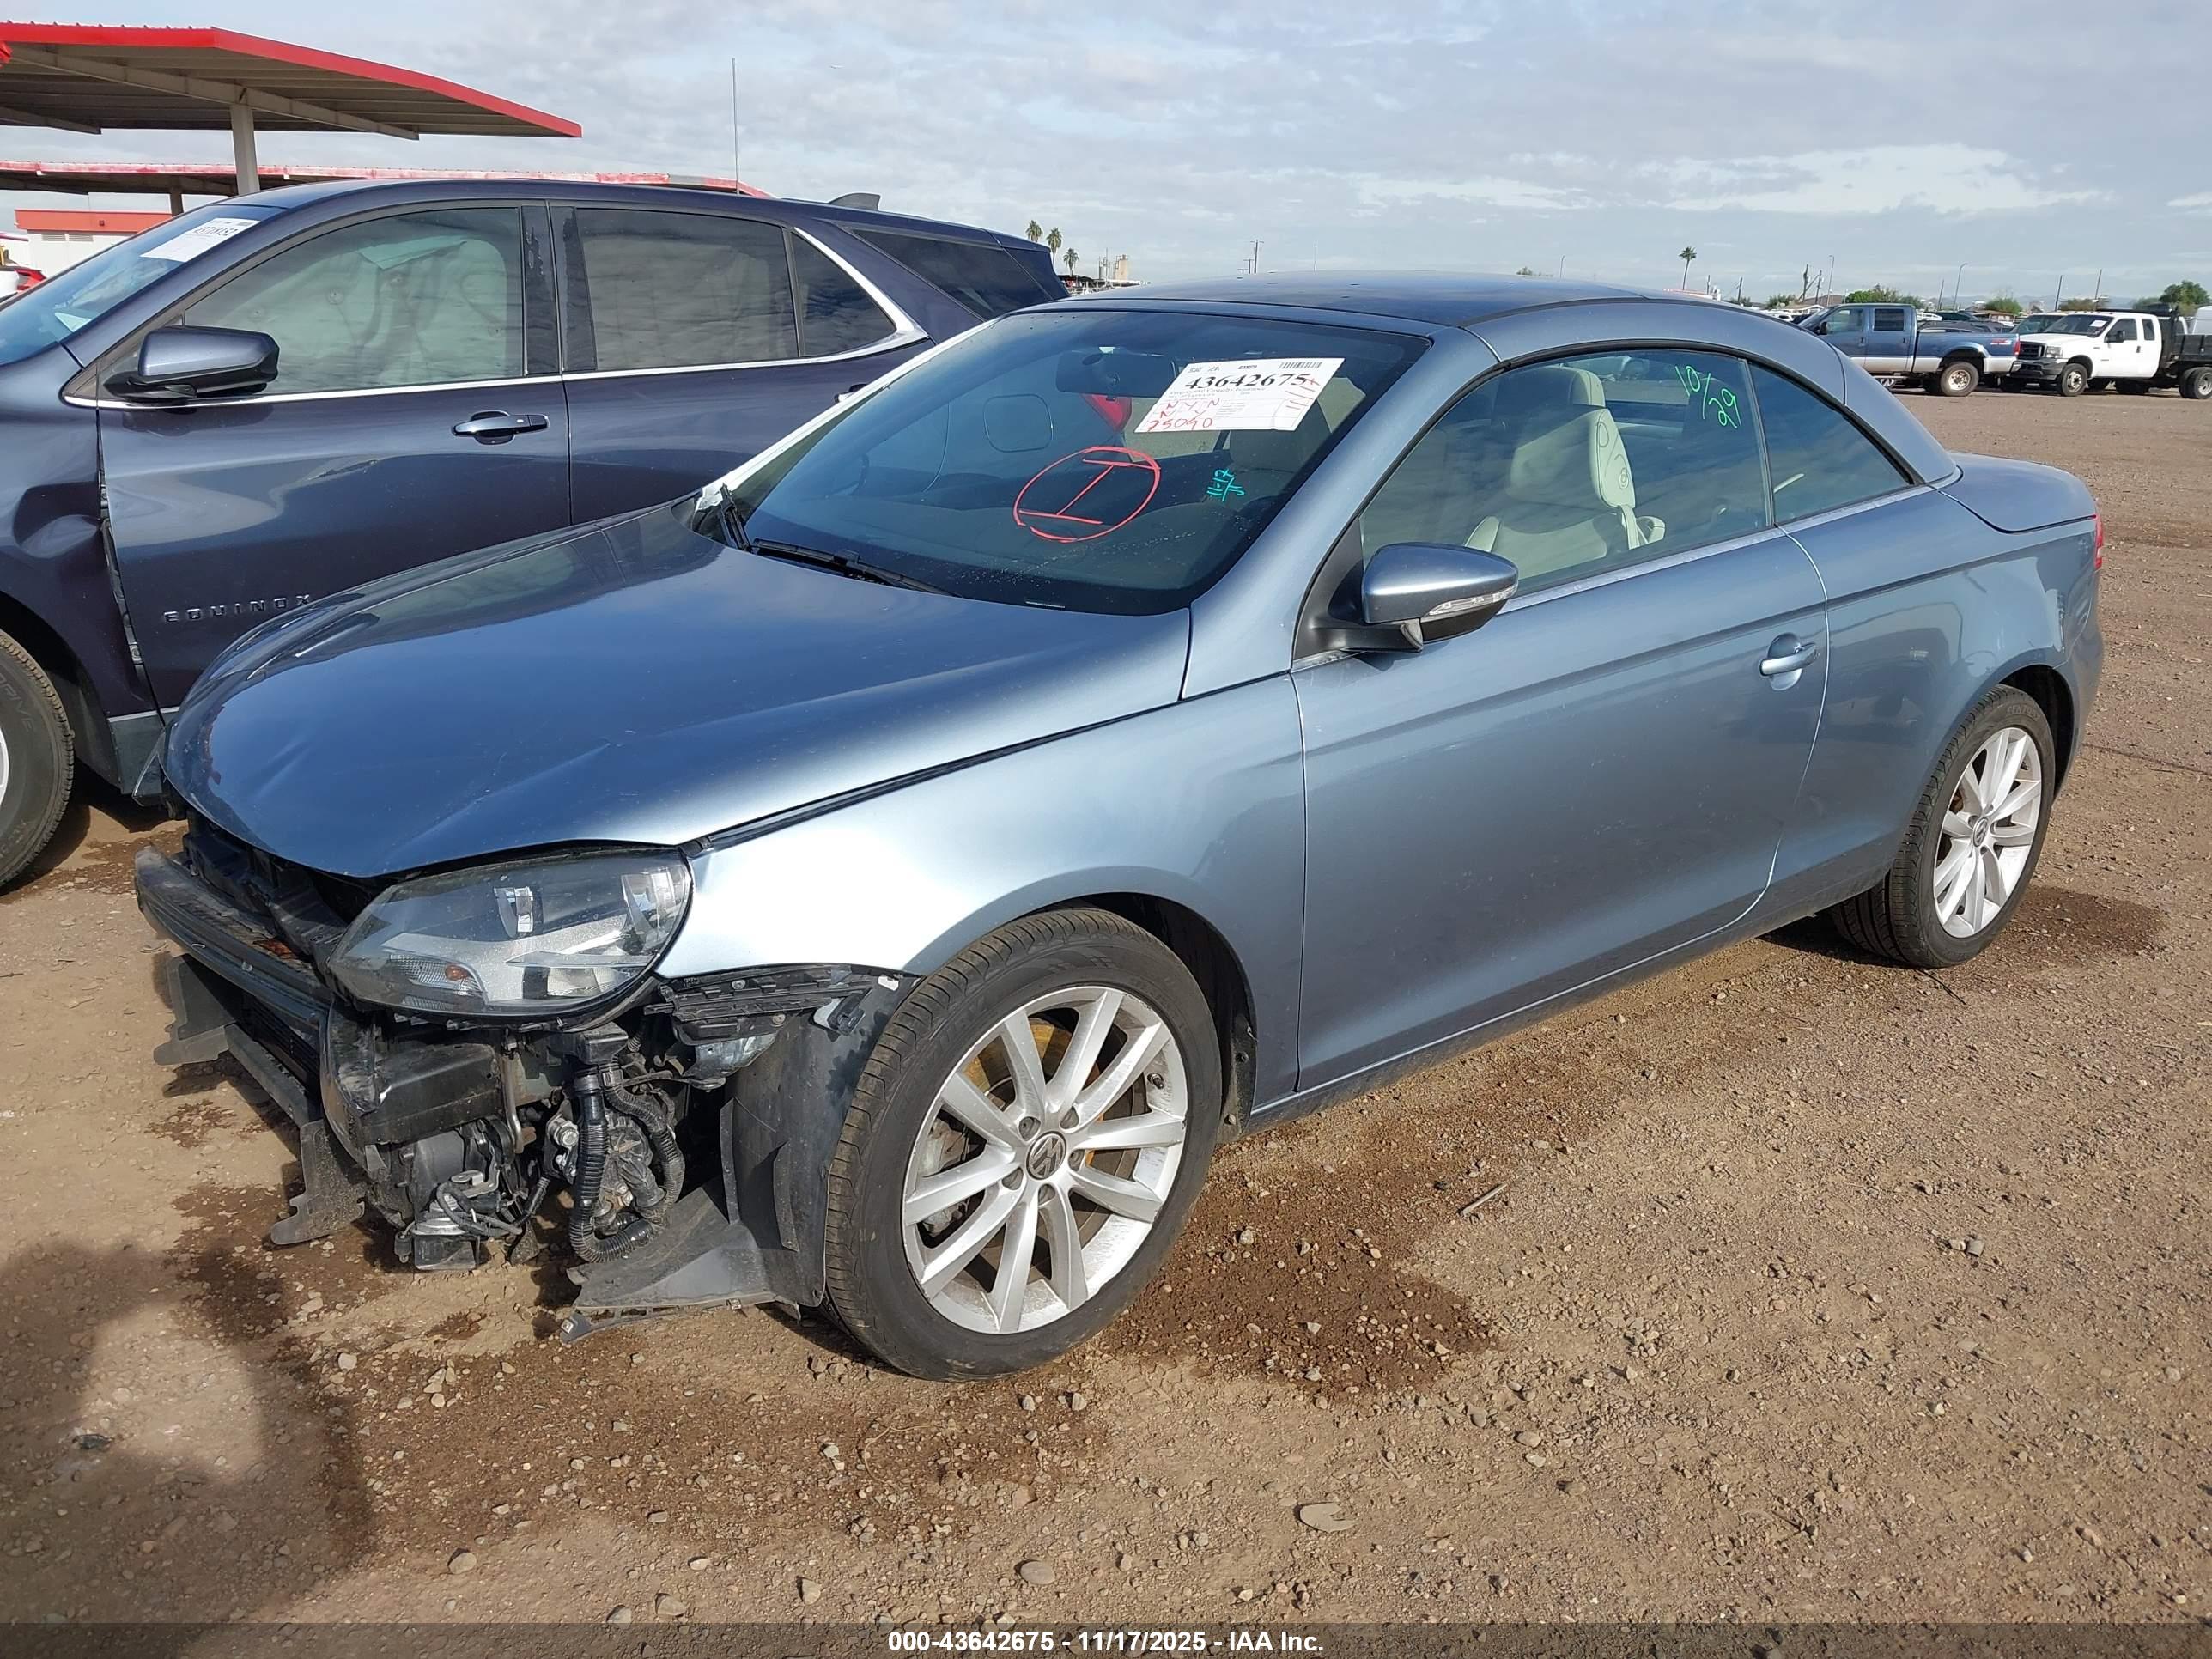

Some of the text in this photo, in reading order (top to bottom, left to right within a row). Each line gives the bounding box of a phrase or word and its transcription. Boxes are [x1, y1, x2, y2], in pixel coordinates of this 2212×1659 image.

[1185, 373, 1312, 389] 43642675
[1674, 364, 1742, 429] 10/29
[162, 593, 311, 623] EQUINOX
